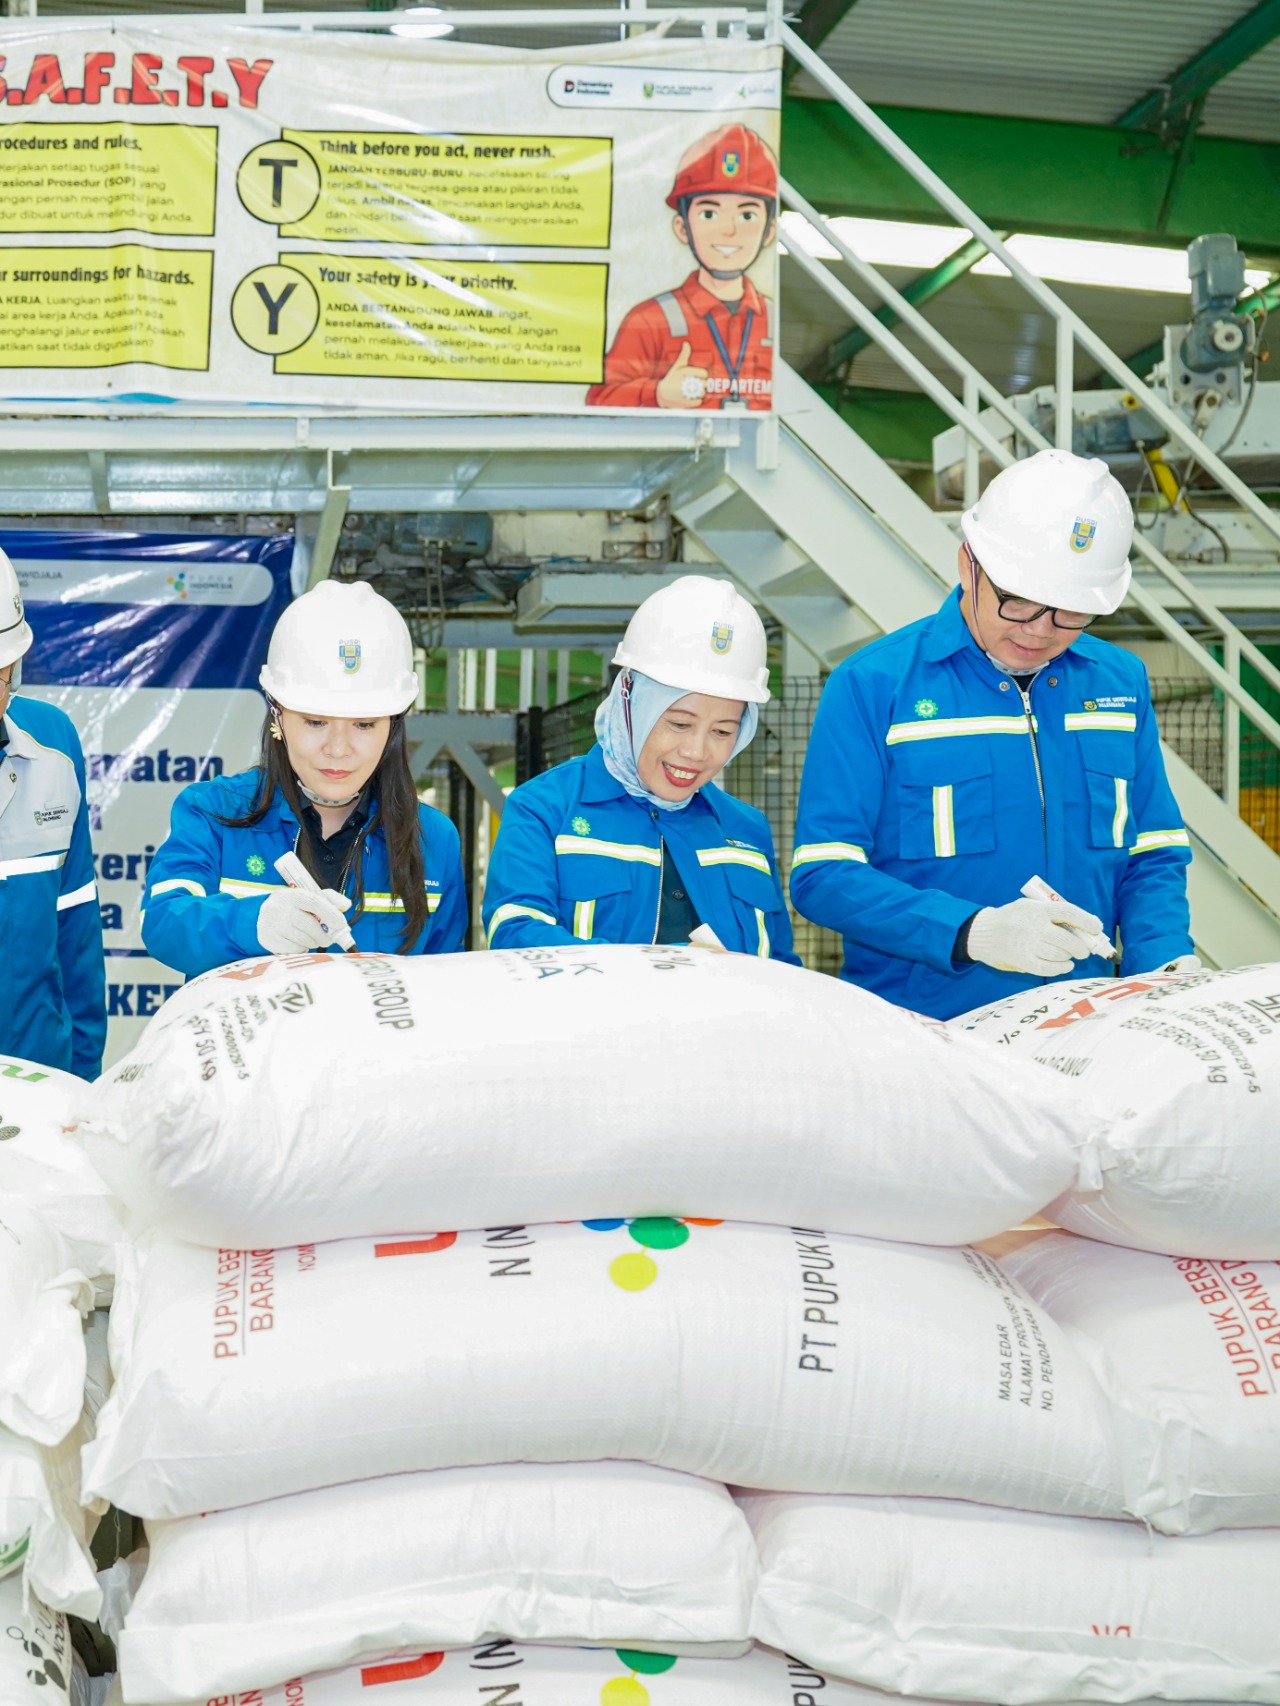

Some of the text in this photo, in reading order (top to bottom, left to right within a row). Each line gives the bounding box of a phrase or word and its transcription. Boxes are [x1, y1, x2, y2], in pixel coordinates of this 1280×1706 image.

[73, 136, 99, 150] and
[104, 135, 143, 151] rules.
[320, 140, 555, 158] Think before you act, never rush.
[47, 178, 101, 188] Prosedur
[103, 177, 136, 189] (SOP)
[259, 158, 298, 208] T
[13, 267, 109, 284] surroundings
[113, 265, 132, 281] for
[137, 264, 194, 285] hazards.
[319, 267, 518, 291] Your safety is priority.
[252, 281, 298, 336] Y
[367, 977, 415, 1031] GROUP
[1207, 1065, 1228, 1085] kg
[213, 1274, 241, 1360] PUPUK
[794, 1240, 841, 1375] PT PUPUK
[996, 1323, 1014, 1402] MASA EDAR
[1207, 1306, 1270, 1397] PUPUK
[1019, 1351, 1033, 1407] ALAMAT
